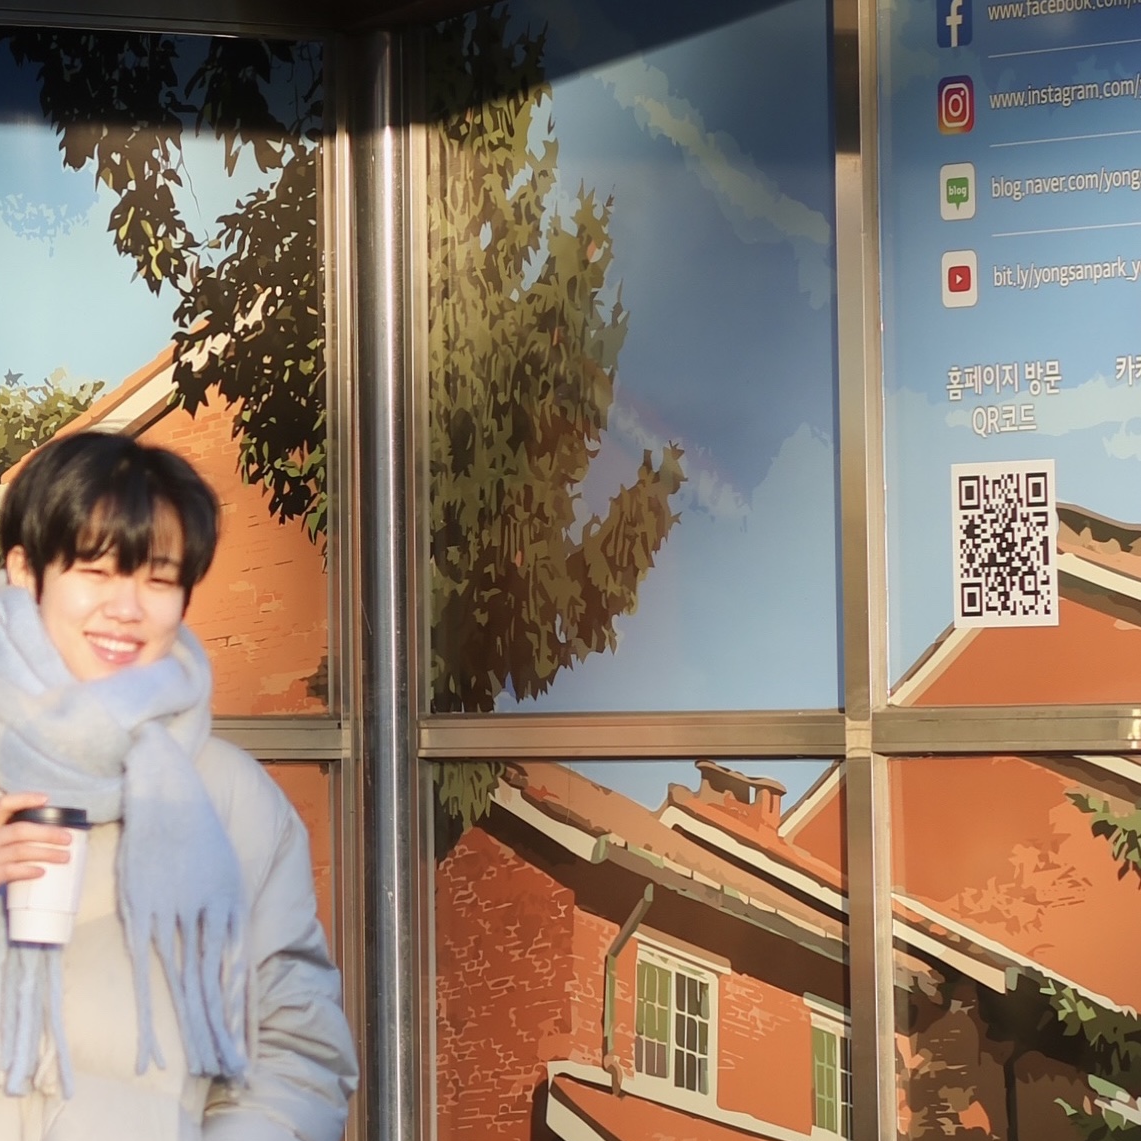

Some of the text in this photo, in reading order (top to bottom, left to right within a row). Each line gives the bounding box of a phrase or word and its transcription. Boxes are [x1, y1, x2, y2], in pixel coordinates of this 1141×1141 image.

[989, 73, 1141, 109] www.instagram.com/
[948, 185, 967, 198] blog
[991, 166, 1141, 201] blog.naver.com/yong
[993, 255, 1141, 290] bit.ly/yongsanpark_y
[946, 359, 1063, 401] 홈페이지 방문
[972, 403, 1037, 438] QR코드
